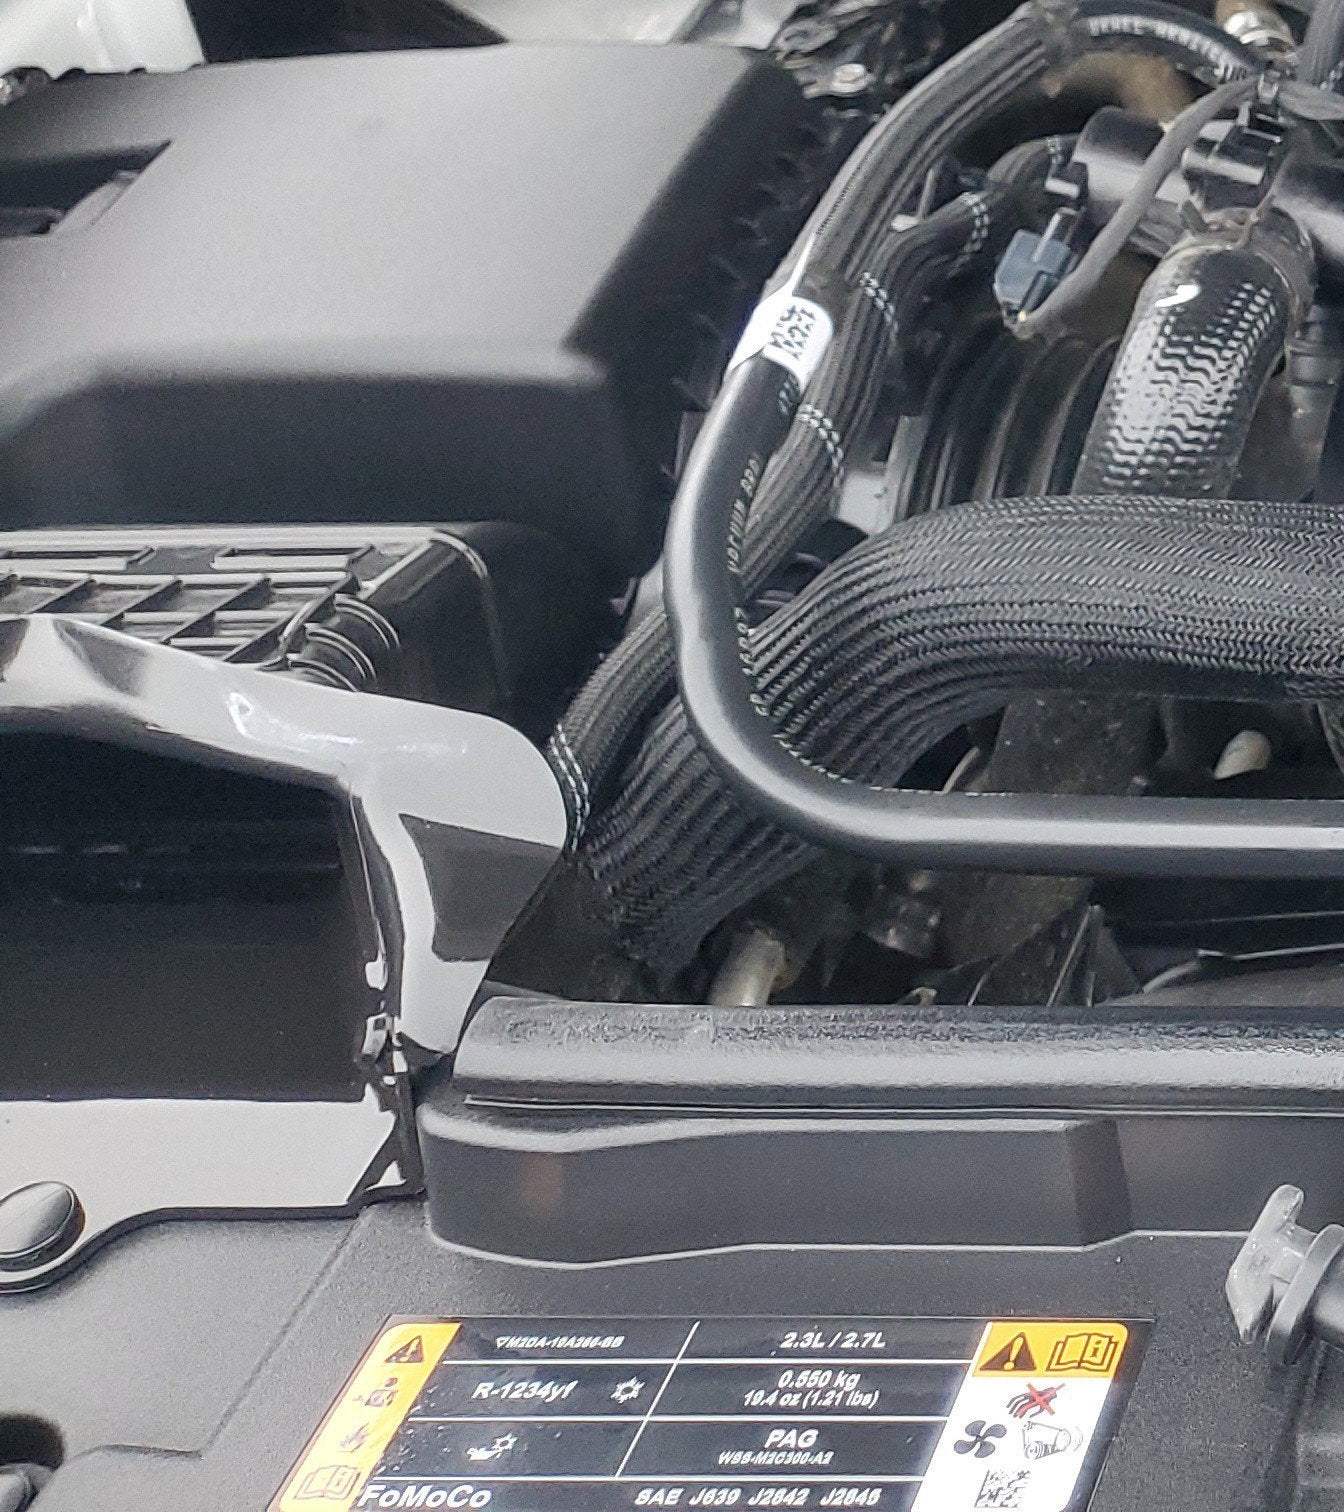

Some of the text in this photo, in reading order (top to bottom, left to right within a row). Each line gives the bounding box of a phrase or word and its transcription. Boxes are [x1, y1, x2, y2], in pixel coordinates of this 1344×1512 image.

[780, 1332, 886, 1348] 2.3L / 2.7L
[834, 1370, 861, 1391] kg
[471, 1380, 579, 1403] R-1234yf
[779, 1393, 802, 1406] oz
[802, 1390, 843, 1409] (1.21
[845, 1390, 880, 1409] lbs)
[764, 1429, 819, 1448] PAG
[356, 1485, 493, 1508] FoMoCo
[635, 1488, 683, 1505] SAE
[689, 1488, 741, 1505] J639
[748, 1488, 810, 1505] J2842
